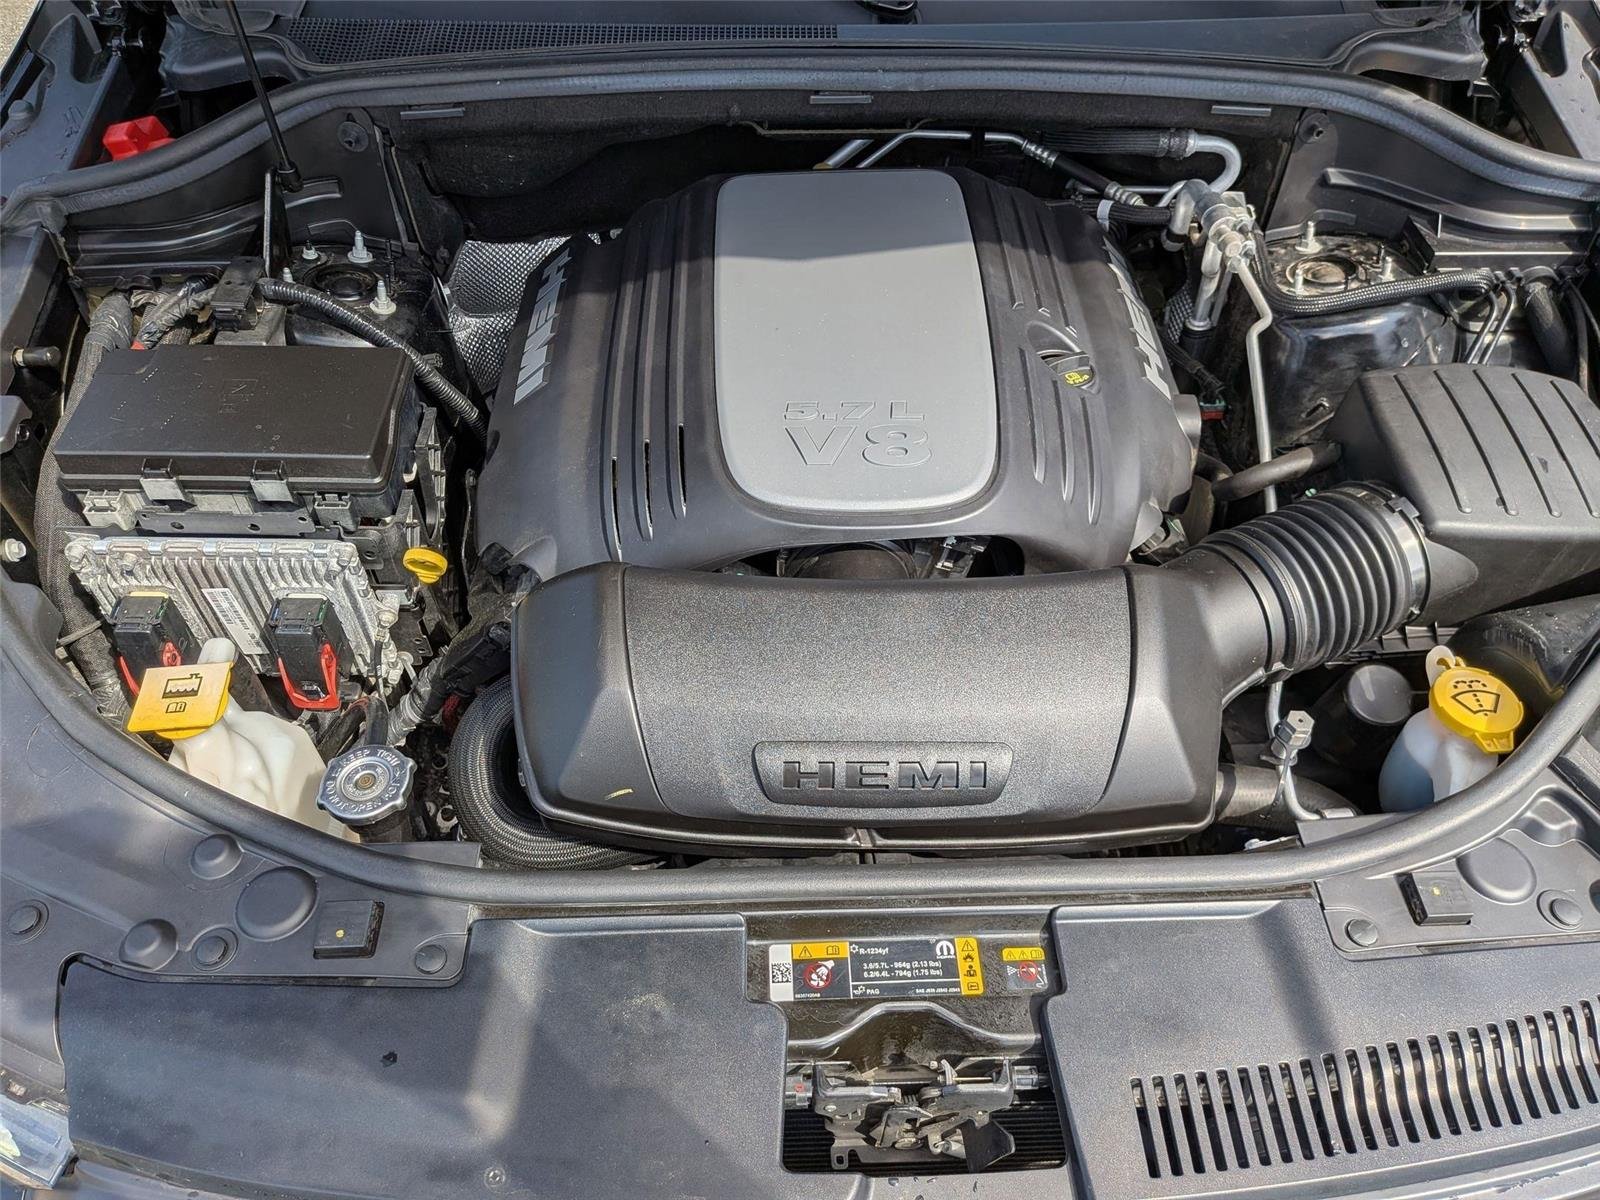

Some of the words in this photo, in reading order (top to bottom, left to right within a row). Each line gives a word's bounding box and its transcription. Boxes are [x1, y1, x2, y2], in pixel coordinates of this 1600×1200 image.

[513, 248, 572, 405] HEMI
[784, 423, 932, 467] V8
[341, 749, 370, 767] KEEP
[376, 749, 400, 766] TIGHT
[782, 761, 987, 790] HEMI
[347, 800, 382, 812] OPEN
[860, 947, 889, 956] R-1234yf
